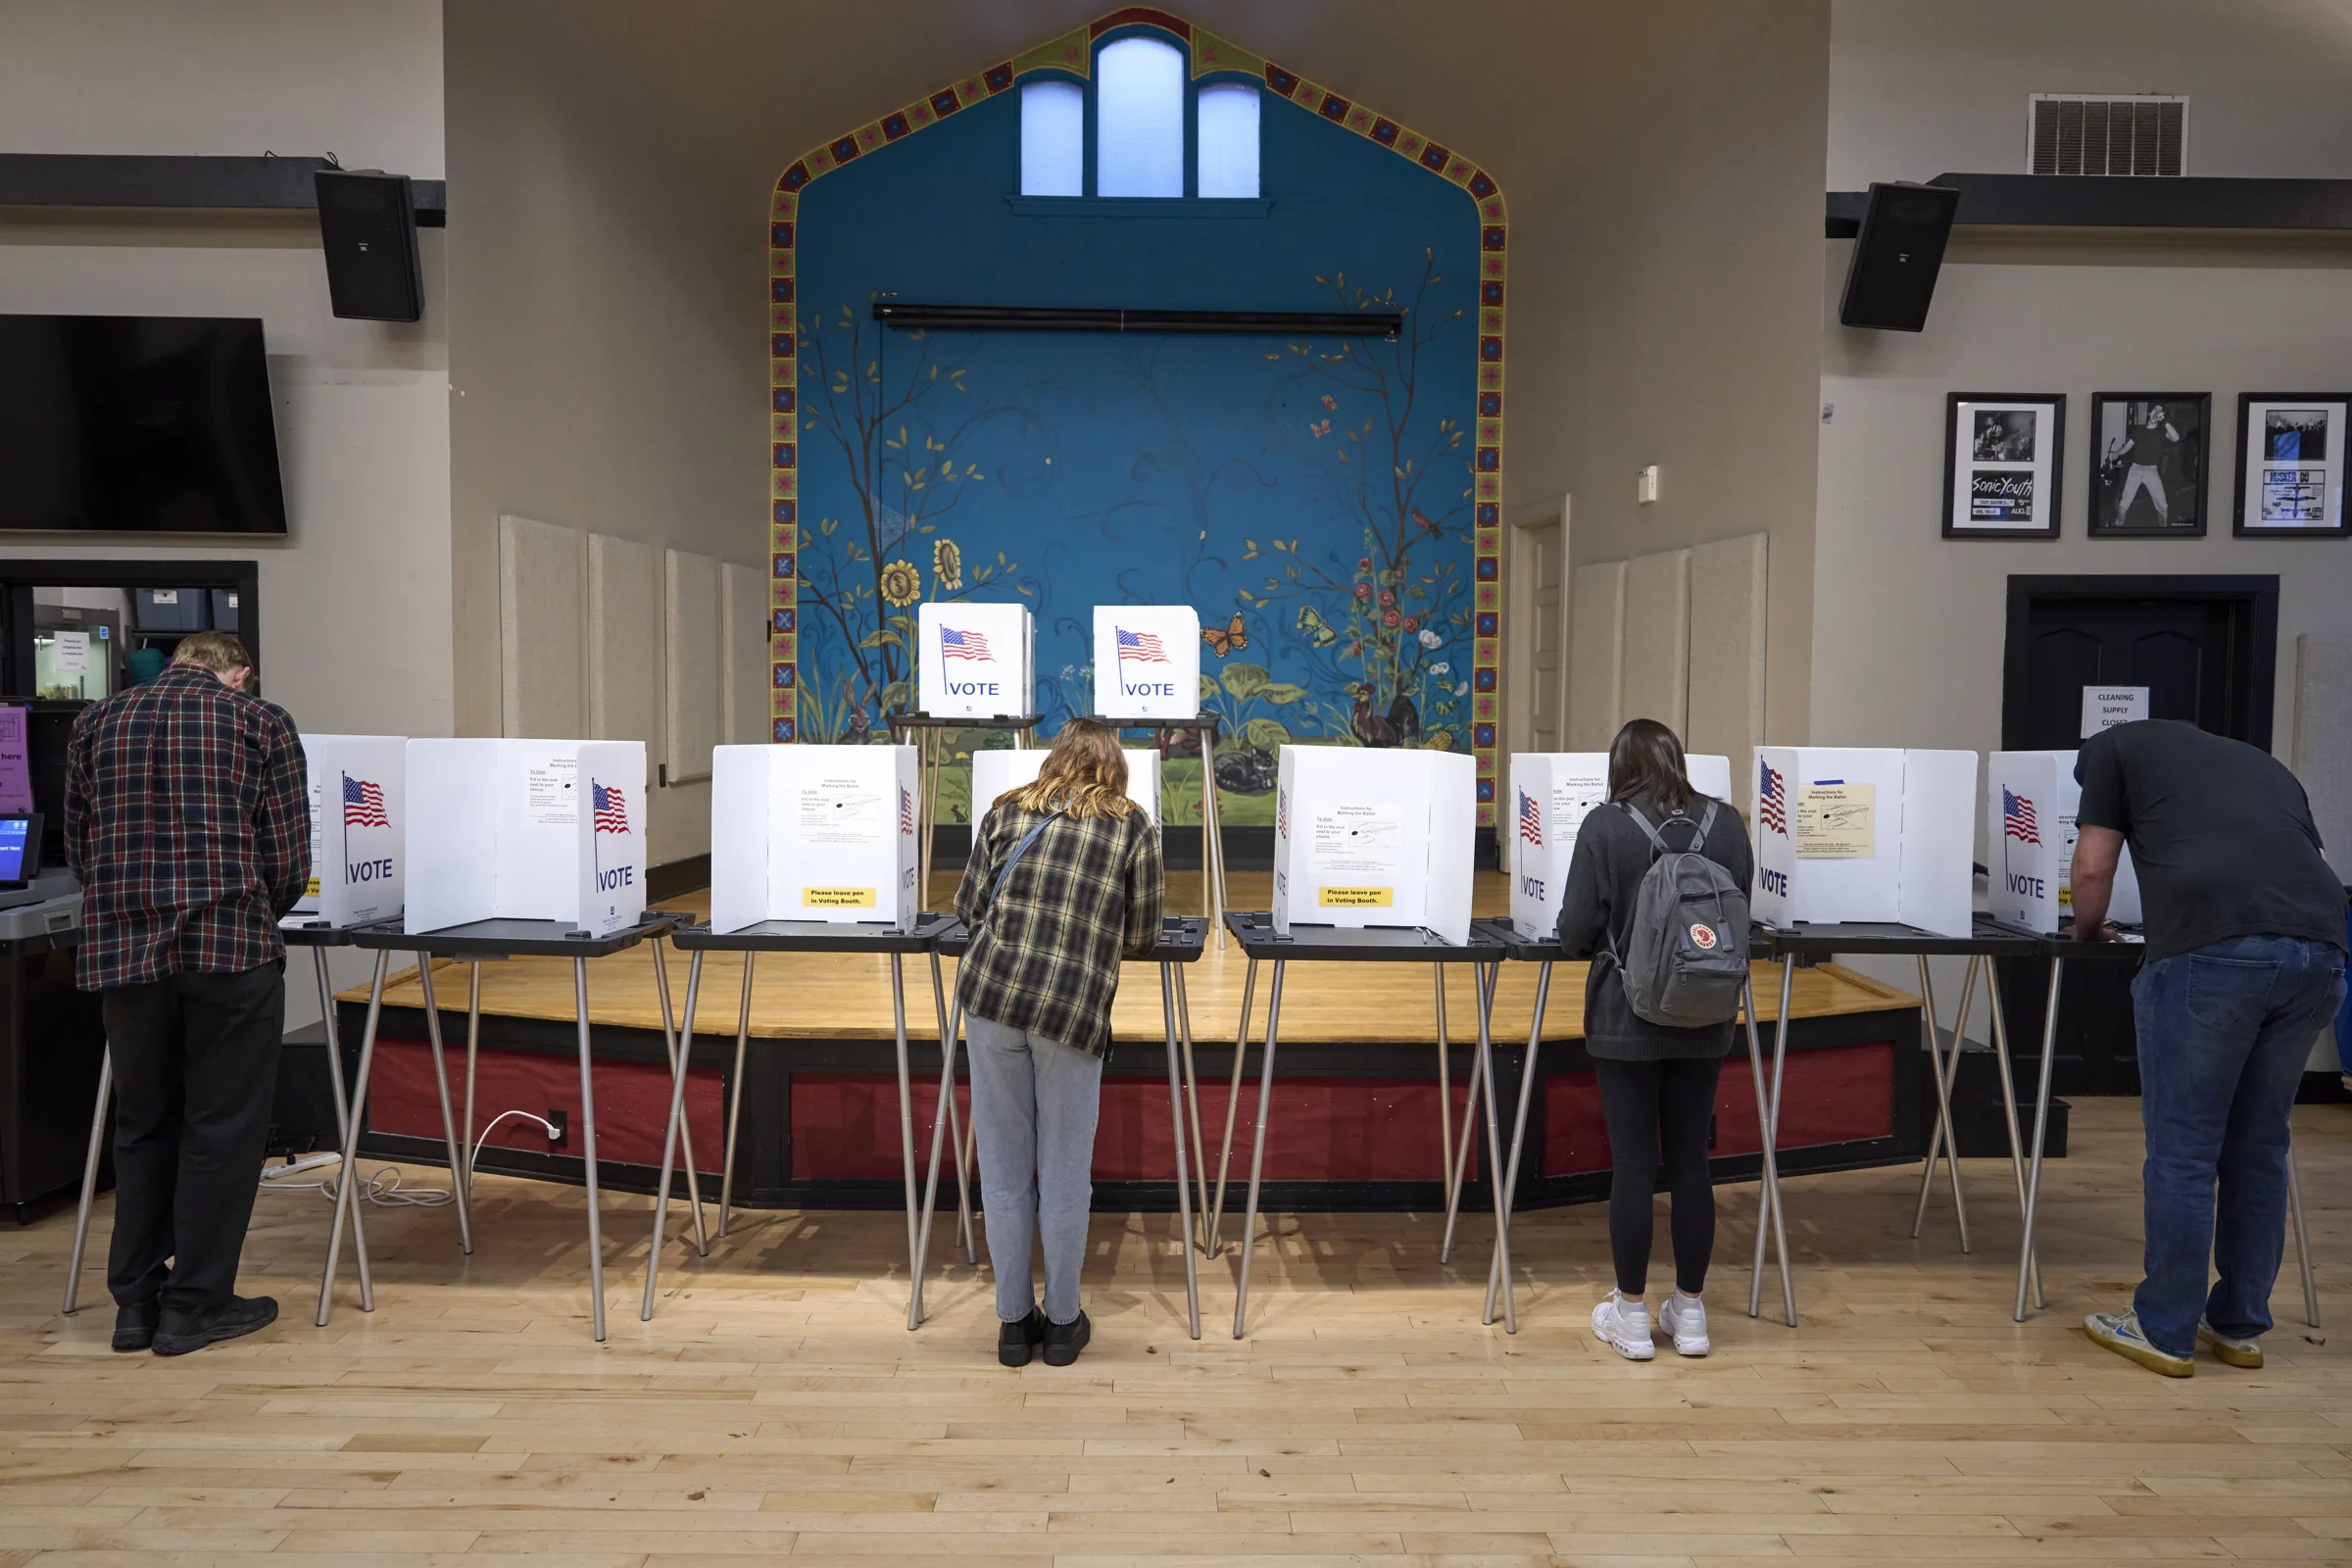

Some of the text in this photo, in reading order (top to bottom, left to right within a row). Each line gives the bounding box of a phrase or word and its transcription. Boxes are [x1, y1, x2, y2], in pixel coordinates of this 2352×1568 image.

[1972, 477, 2033, 497] Sonic Youth
[949, 683, 999, 695] VOTE
[1126, 684, 1174, 696] VOTE
[350, 858, 392, 883] VOTE
[599, 866, 632, 891] VOTE
[1761, 867, 1787, 898] VOTE
[1523, 875, 1544, 901] VOTE
[2009, 873, 2044, 899] VOTE
